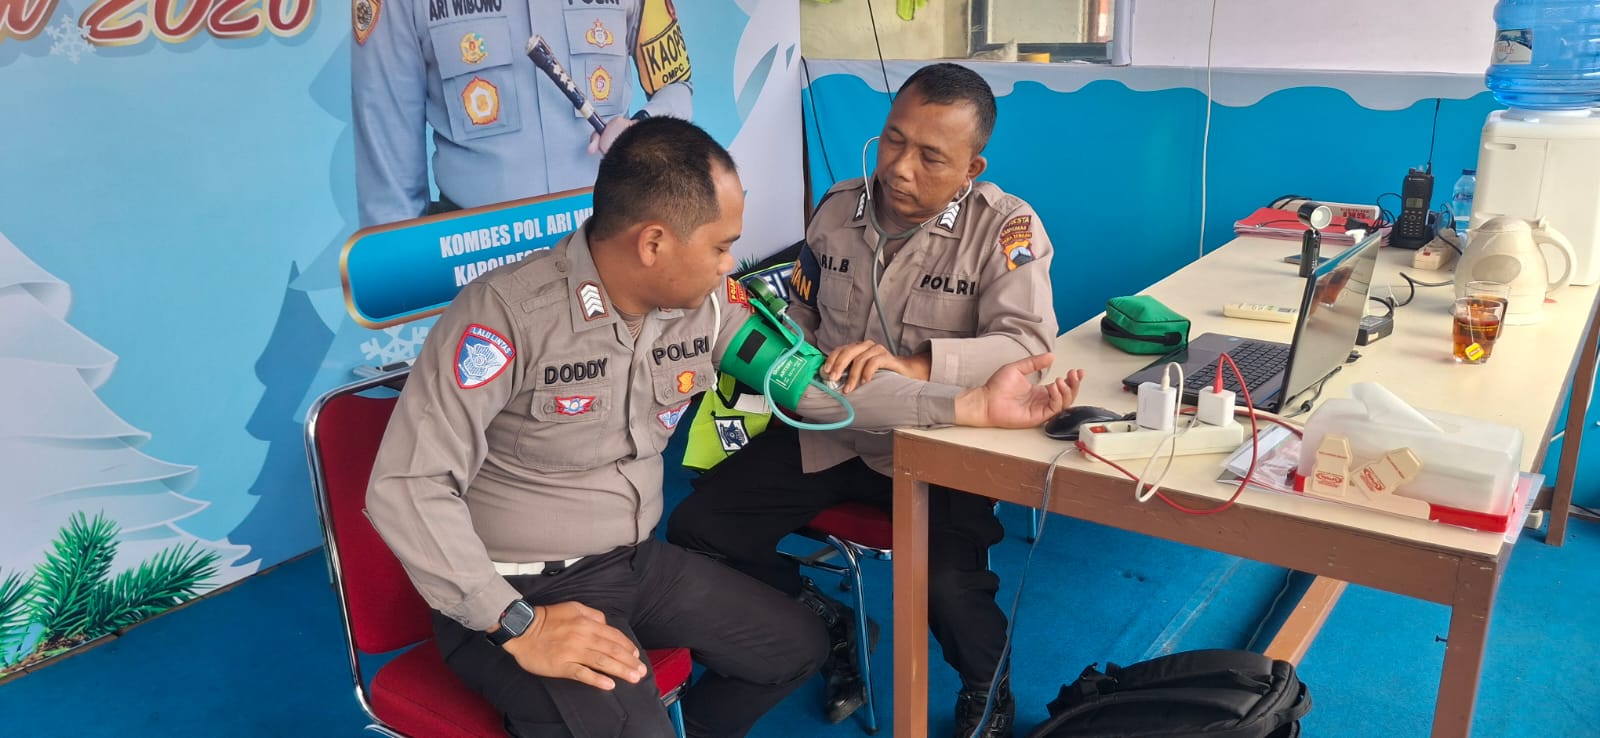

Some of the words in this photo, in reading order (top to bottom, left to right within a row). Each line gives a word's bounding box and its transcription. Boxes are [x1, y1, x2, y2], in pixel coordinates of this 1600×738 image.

[429, 0, 449, 21] ARI
[439, 224, 512, 258] KOMBES
[513, 217, 544, 243] POL
[546, 211, 573, 236] ARI
[920, 274, 976, 295] POLRI
[652, 335, 710, 366] POLRI
[544, 357, 608, 385] DODDY
